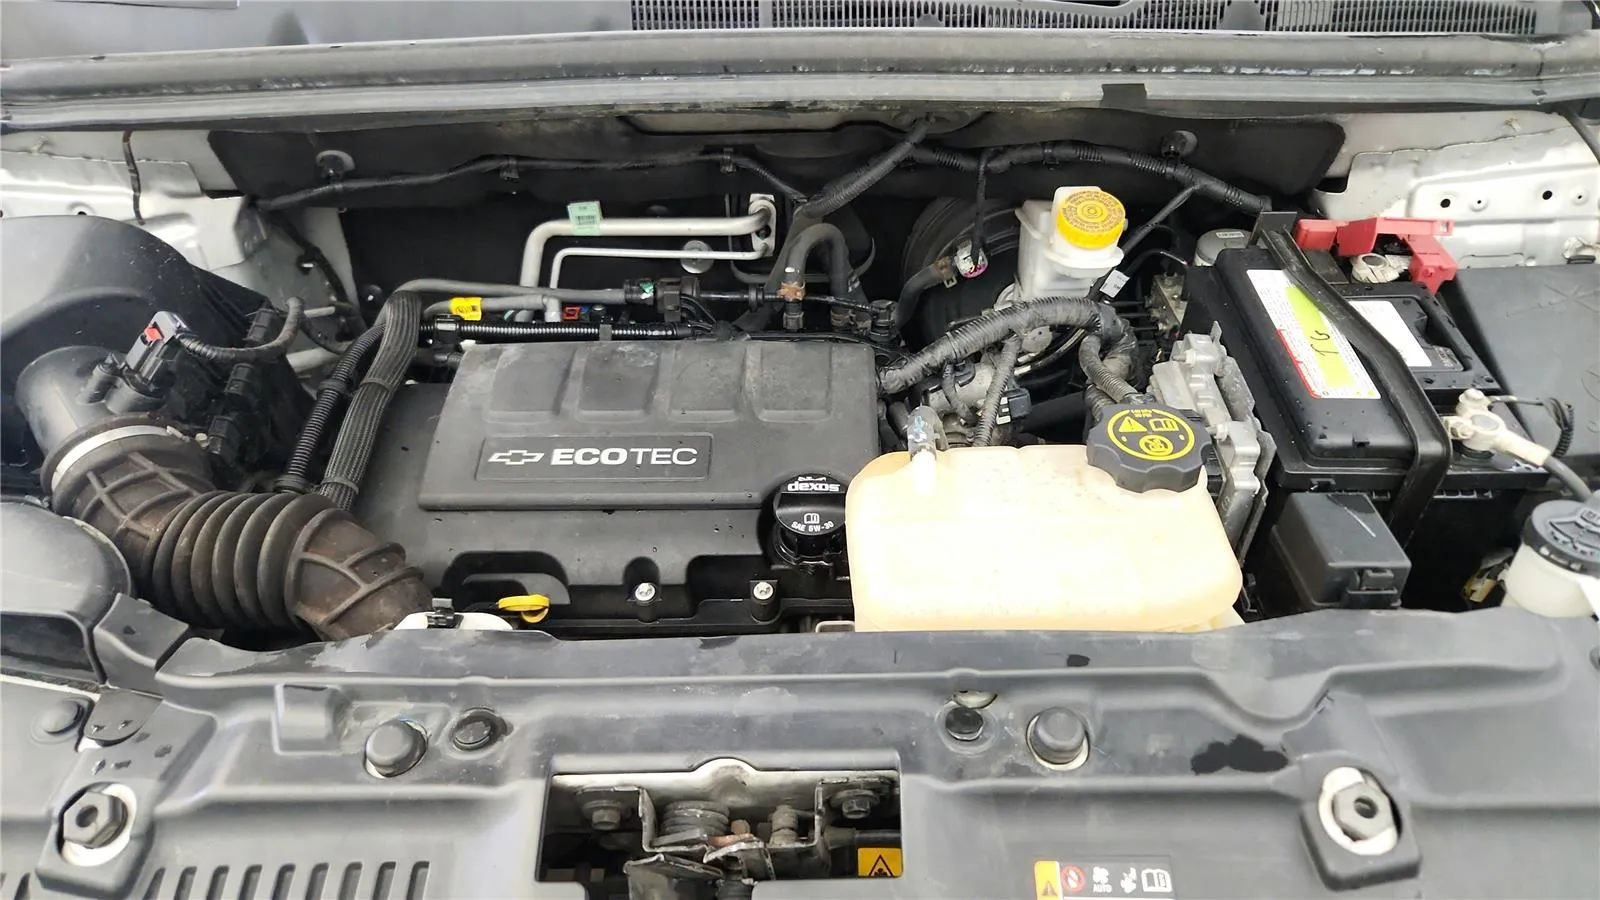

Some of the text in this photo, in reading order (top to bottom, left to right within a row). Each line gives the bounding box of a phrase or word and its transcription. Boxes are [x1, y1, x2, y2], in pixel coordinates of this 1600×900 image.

[550, 447, 698, 466] ECOTEC
[787, 480, 841, 492] dexos
[791, 520, 807, 532] SAE
[1092, 883, 1113, 893] AUTO
